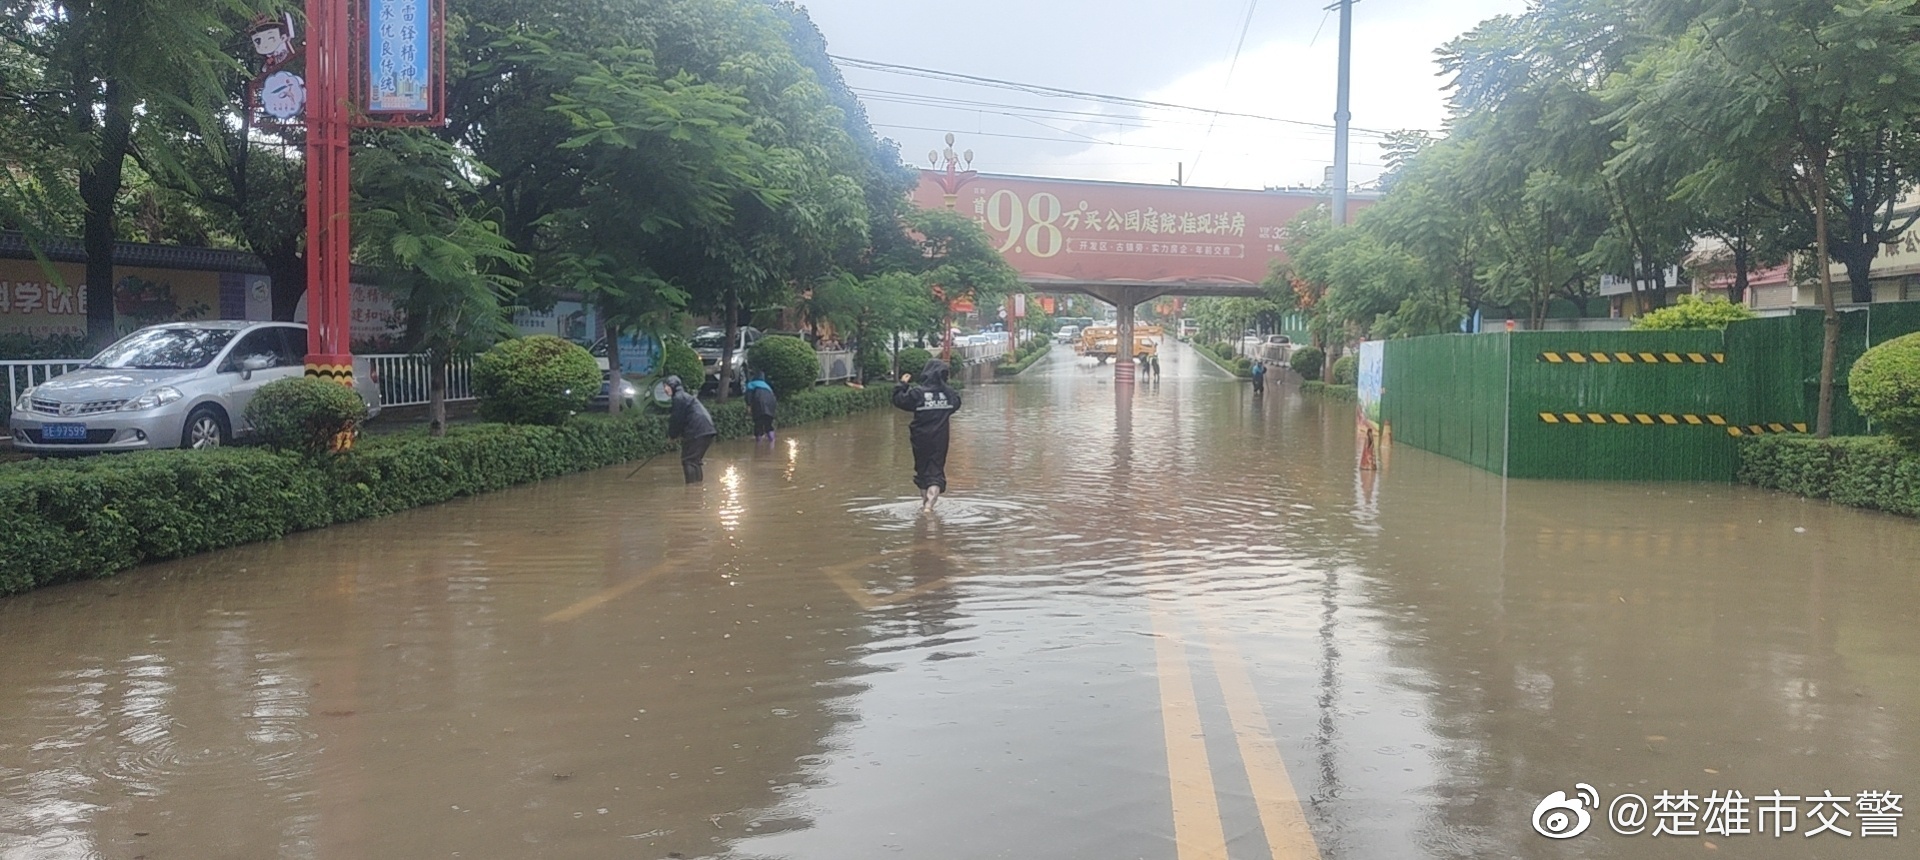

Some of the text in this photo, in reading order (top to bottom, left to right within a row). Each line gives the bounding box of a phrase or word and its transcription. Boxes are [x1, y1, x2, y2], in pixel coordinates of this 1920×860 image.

[380, 0, 395, 91] 承优良传统
[400, 0, 417, 81] 雷锋精神
[987, 189, 1062, 257] 9.8
